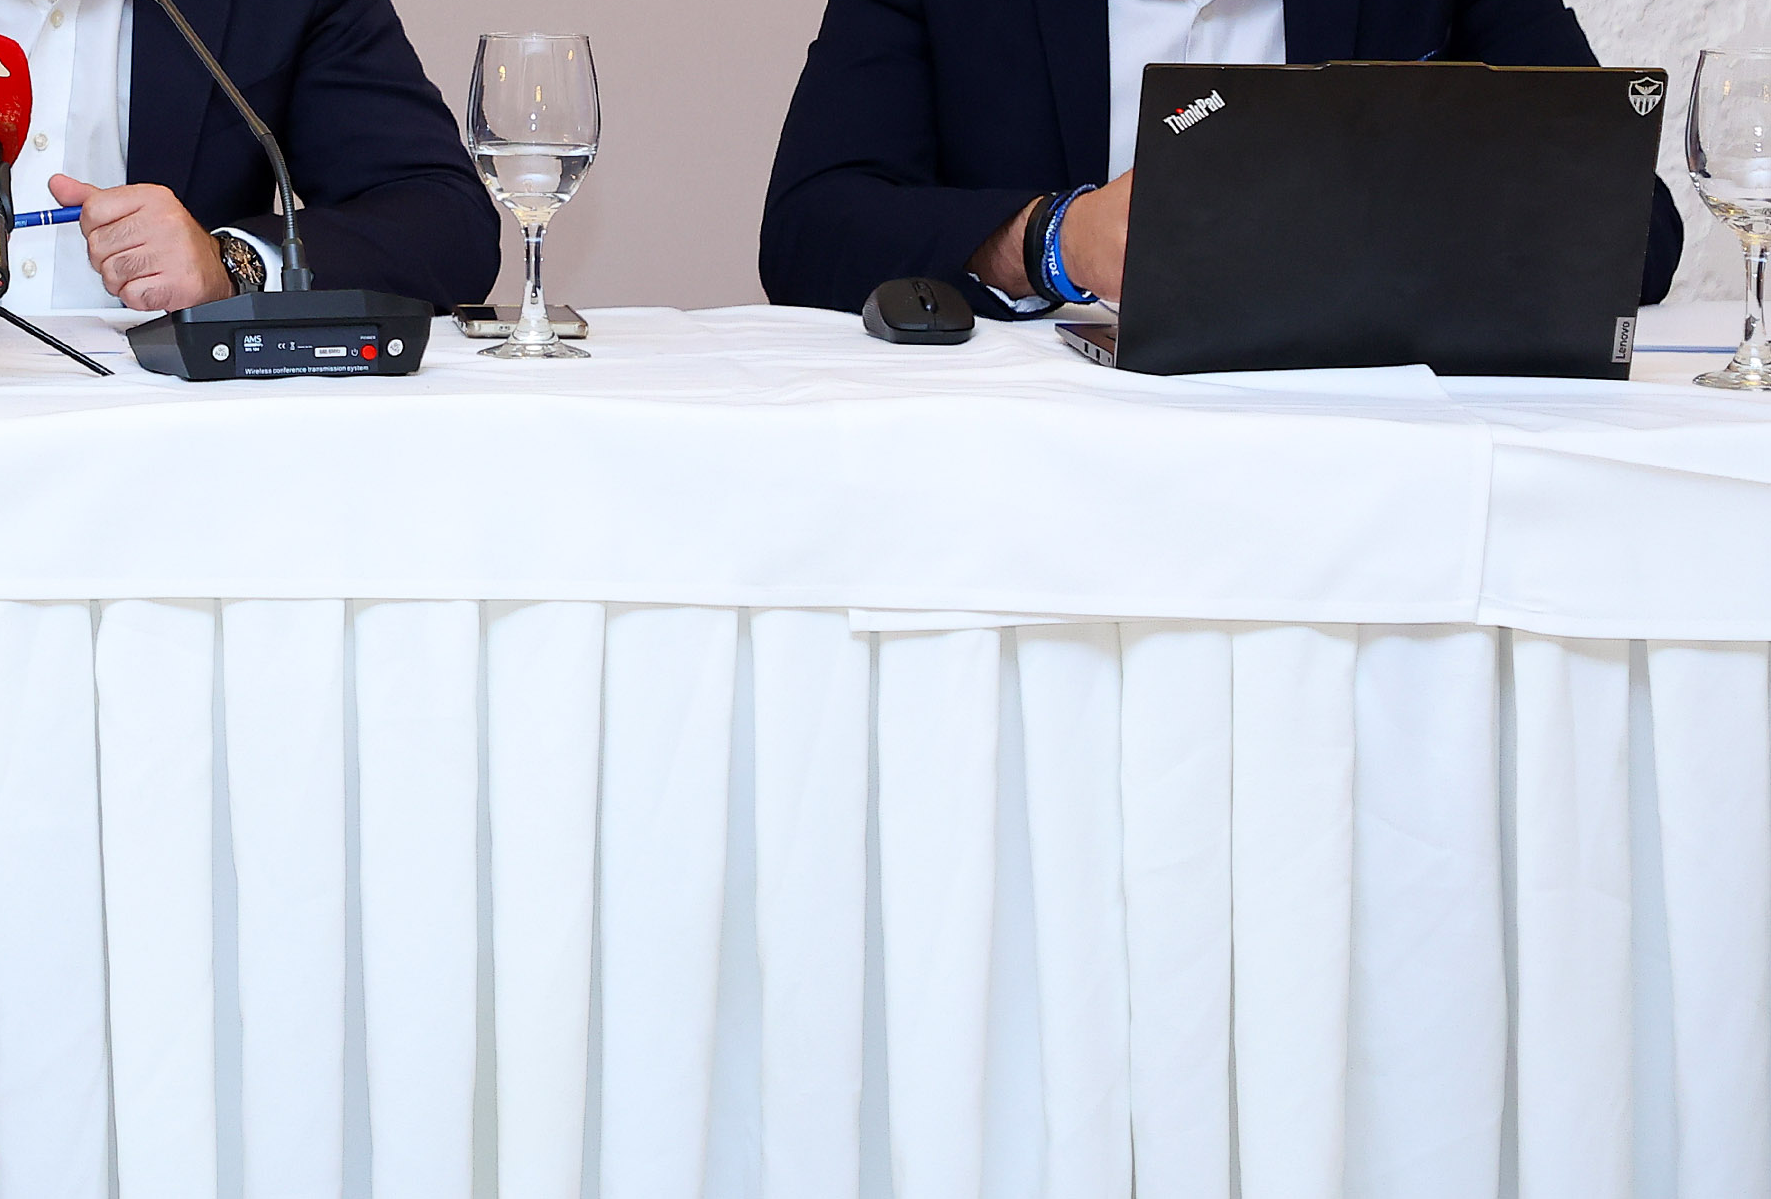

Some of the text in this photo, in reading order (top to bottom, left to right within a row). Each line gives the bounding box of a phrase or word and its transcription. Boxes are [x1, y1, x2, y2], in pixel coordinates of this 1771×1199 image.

[1162, 89, 1226, 135] ThinkPad
[244, 335, 262, 343] AMS
[1615, 321, 1630, 359] Lenovo
